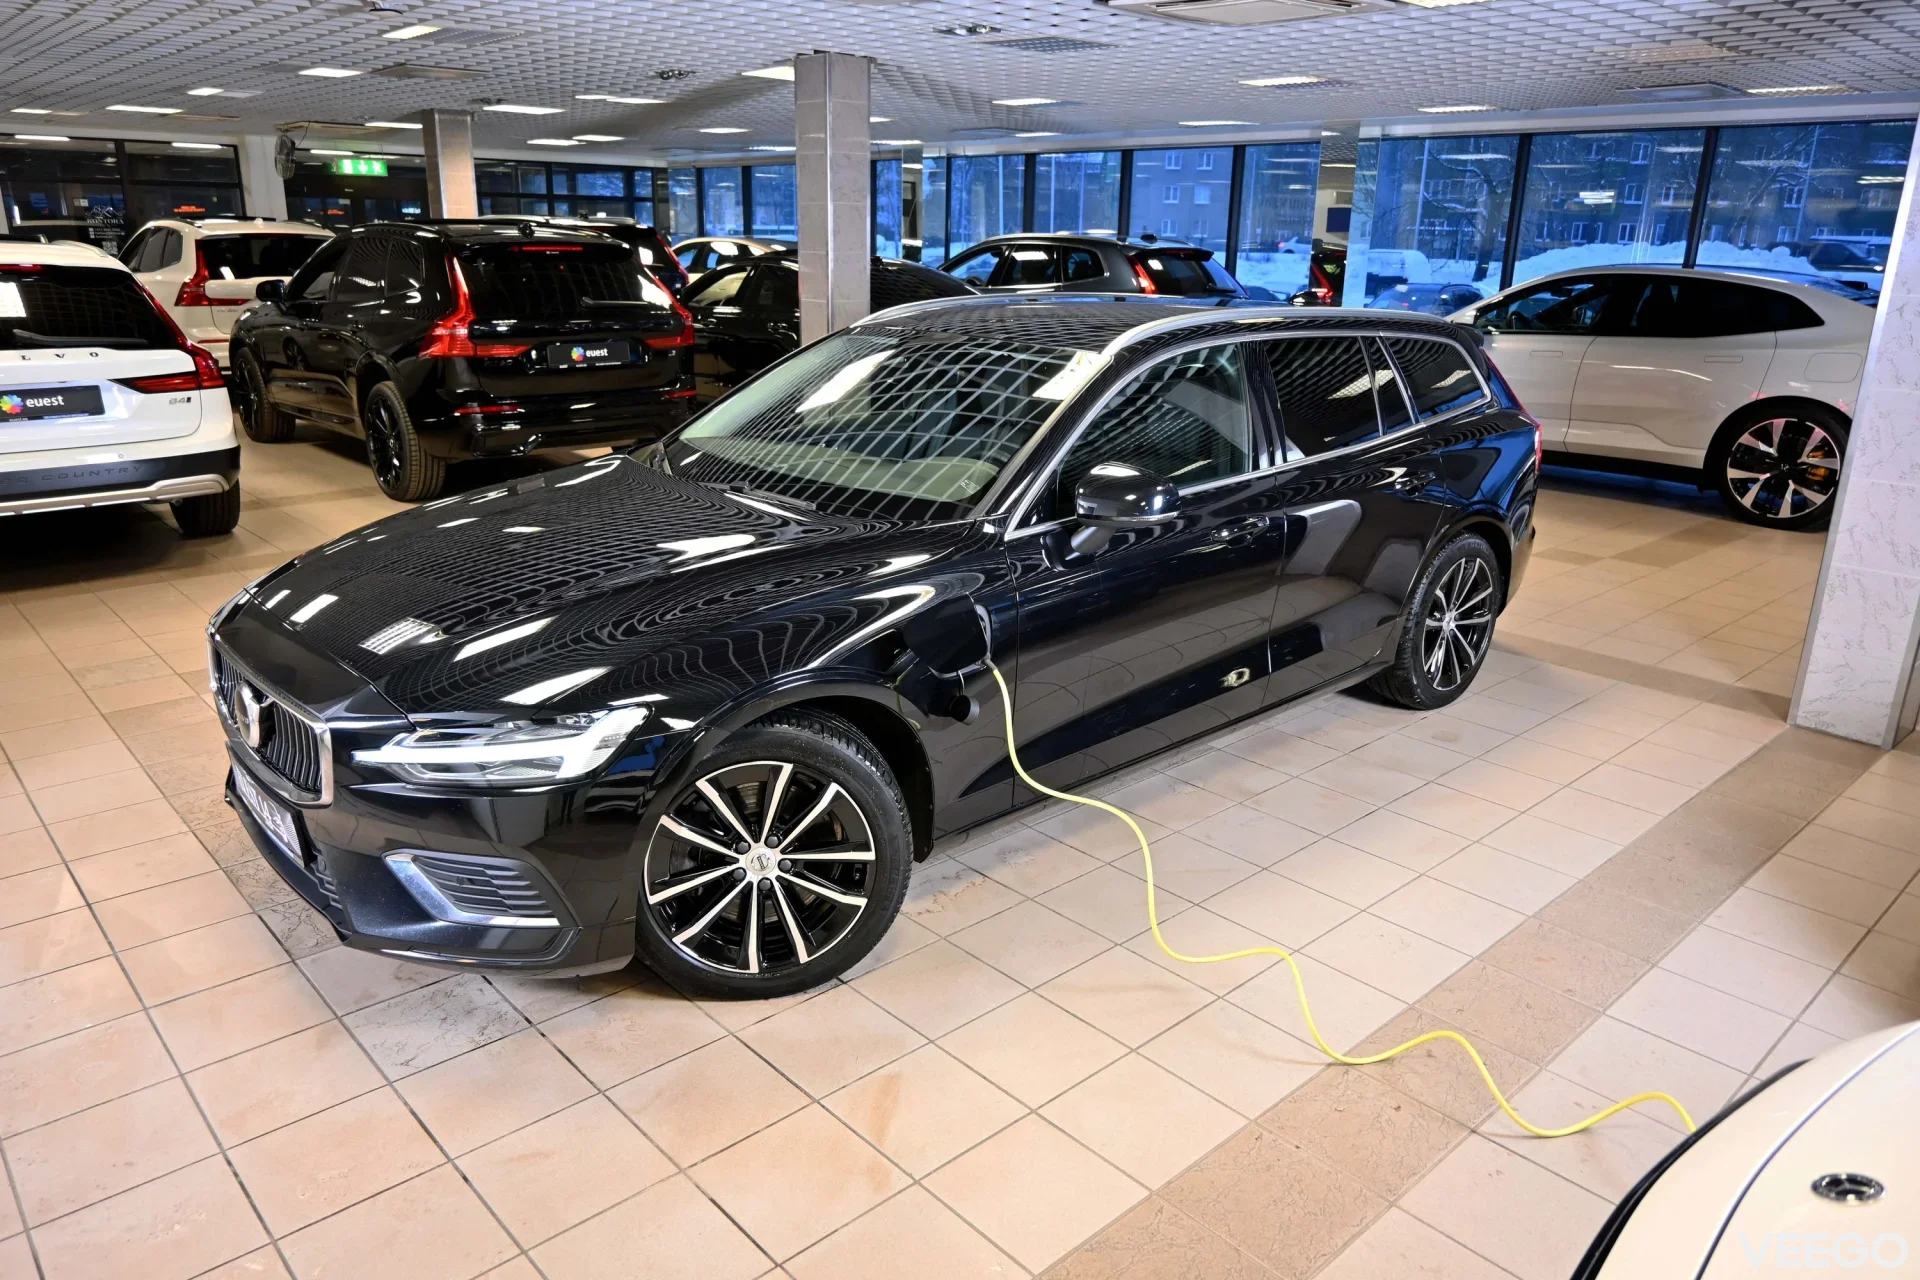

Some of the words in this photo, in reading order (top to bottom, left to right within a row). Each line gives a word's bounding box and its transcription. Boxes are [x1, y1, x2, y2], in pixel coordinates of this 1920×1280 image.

[586, 348, 609, 358] euest
[26, 395, 65, 408] euest
[41, 465, 143, 481] COUNTRY
